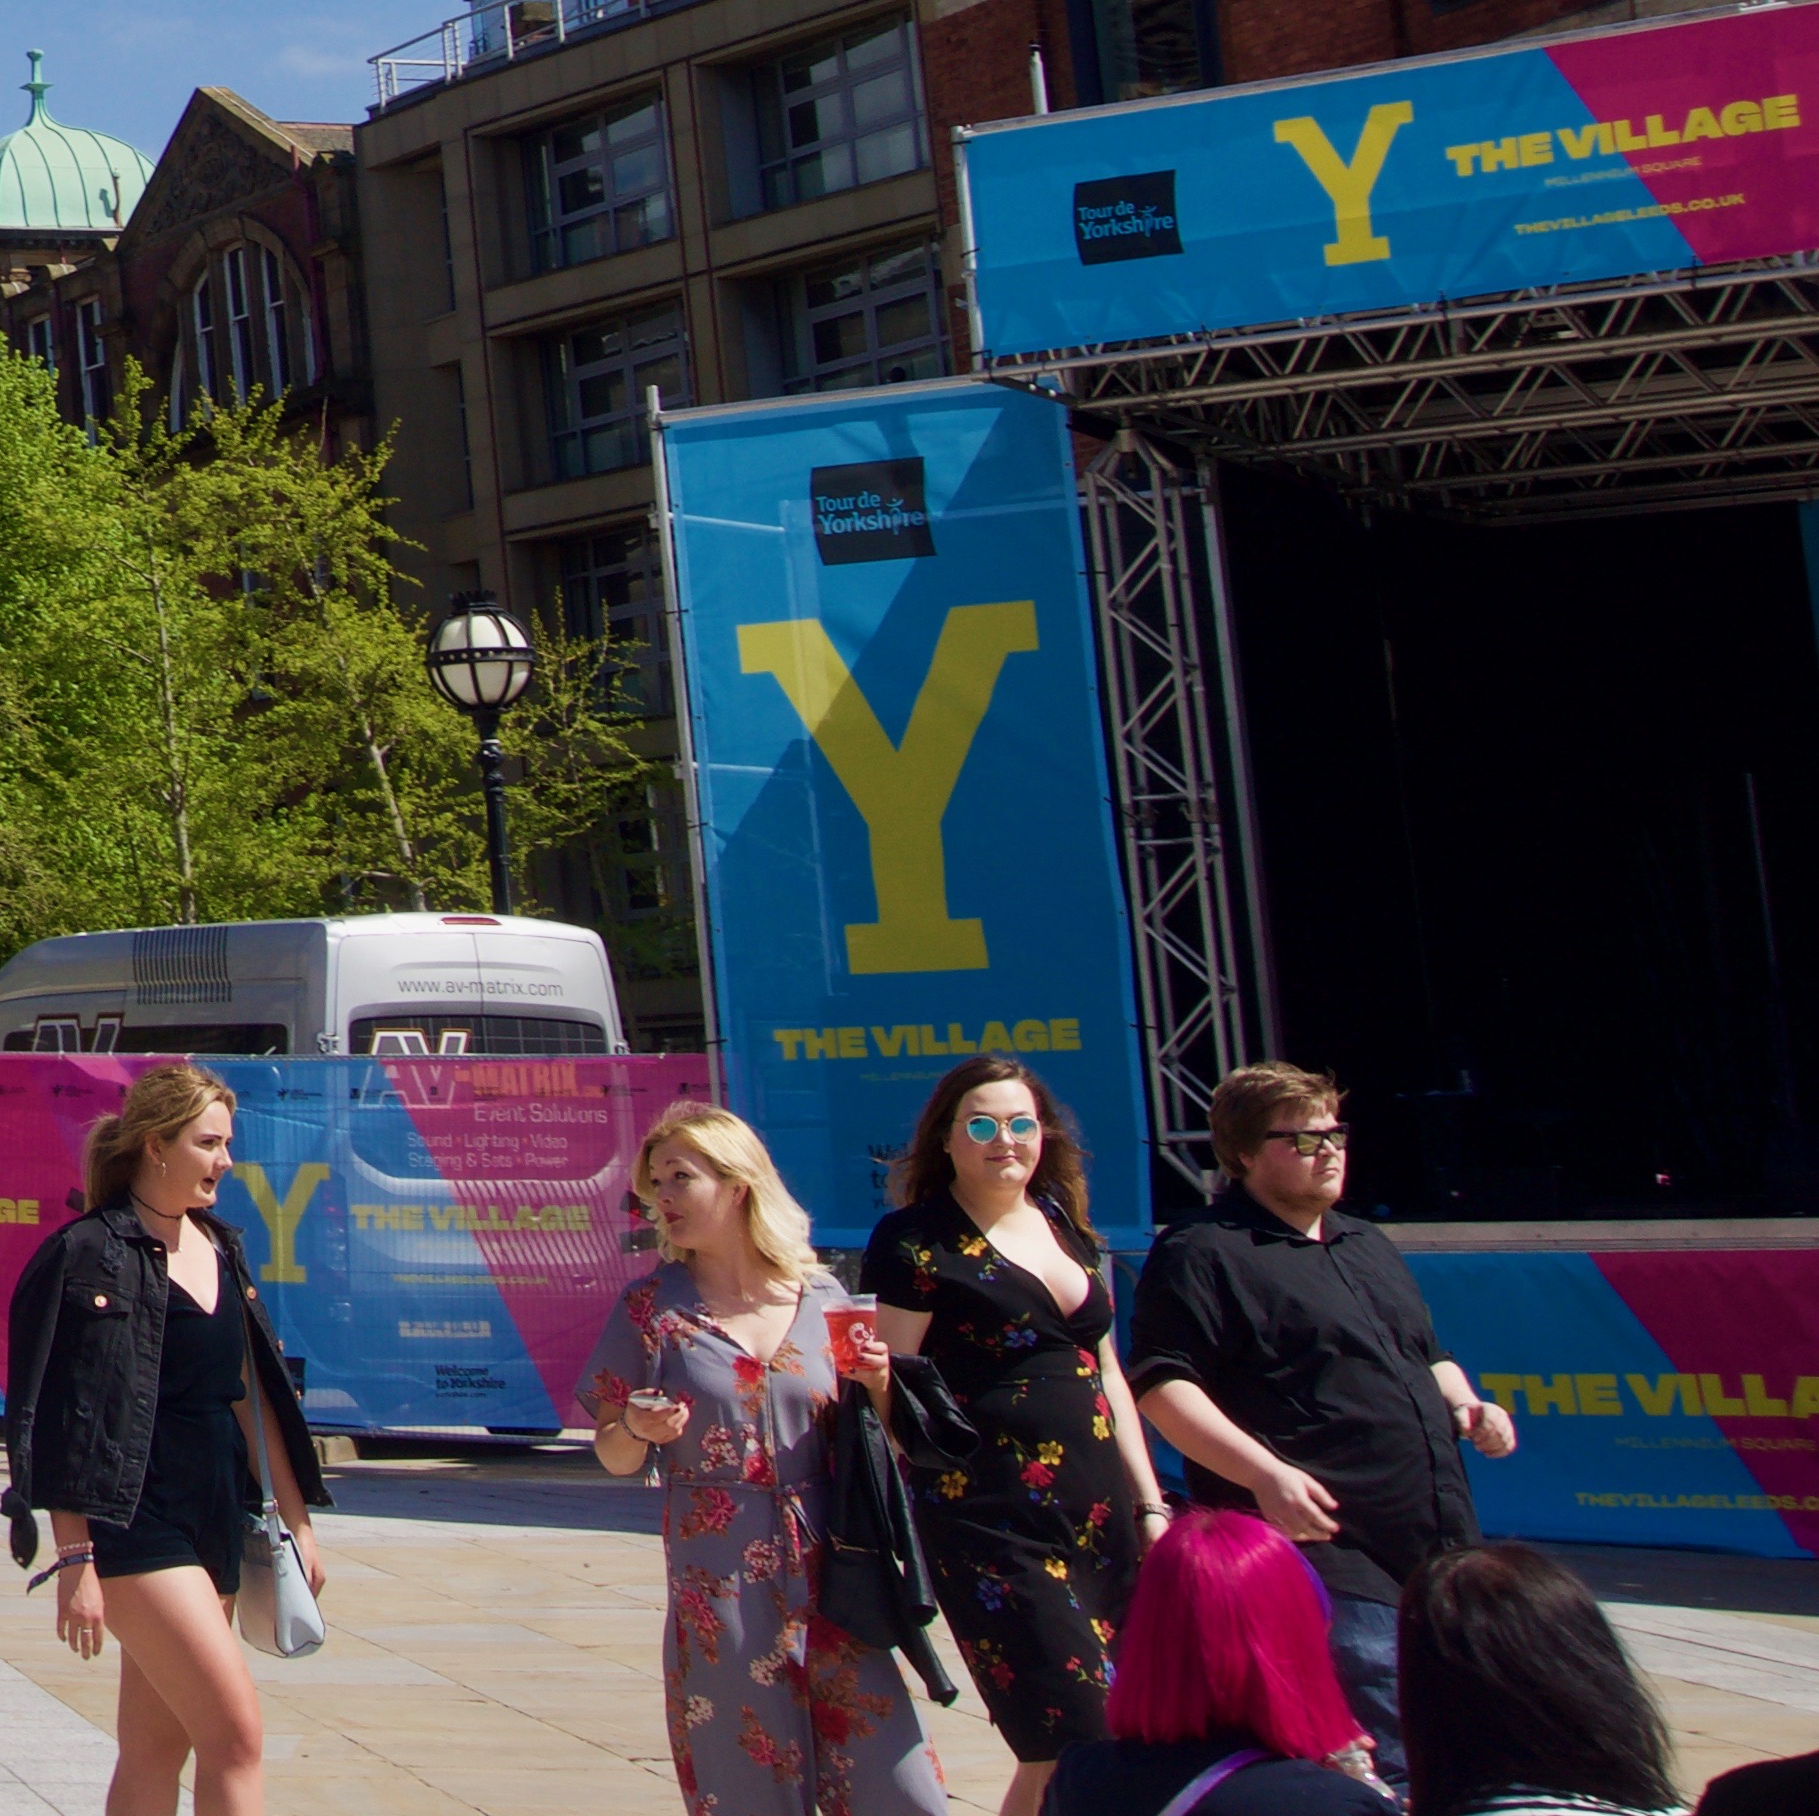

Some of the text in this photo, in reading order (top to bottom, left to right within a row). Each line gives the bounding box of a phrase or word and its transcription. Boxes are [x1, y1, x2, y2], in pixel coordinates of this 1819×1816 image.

[1445, 94, 1801, 177] THE VILLAGE
[1642, 156, 1703, 177] SQUARE
[1273, 100, 1414, 268] Y
[1077, 200, 1135, 220] Tour de
[1516, 193, 1746, 235] THEVILLAGELEEDS.CO.UK
[1078, 209, 1174, 240] Yorkshire
[816, 491, 881, 512] Tour de
[818, 506, 925, 535] Yorkshire
[736, 600, 1039, 975] Y
[398, 979, 563, 997] www.av-matrix.com
[774, 1018, 1082, 1061] THE VILLAGE
[474, 1102, 608, 1124] Event Solutions
[407, 1133, 568, 1152] Sound Lighting Video
[525, 1152, 568, 1168] Power
[232, 1162, 330, 1284] Y
[351, 1204, 592, 1232] THE VILLAGE
[434, 1364, 489, 1377] Welcome
[436, 1378, 506, 1390] to Yorkshire
[1479, 1373, 1623, 1416] THE
[1741, 1438, 1817, 1451] SQUARE
